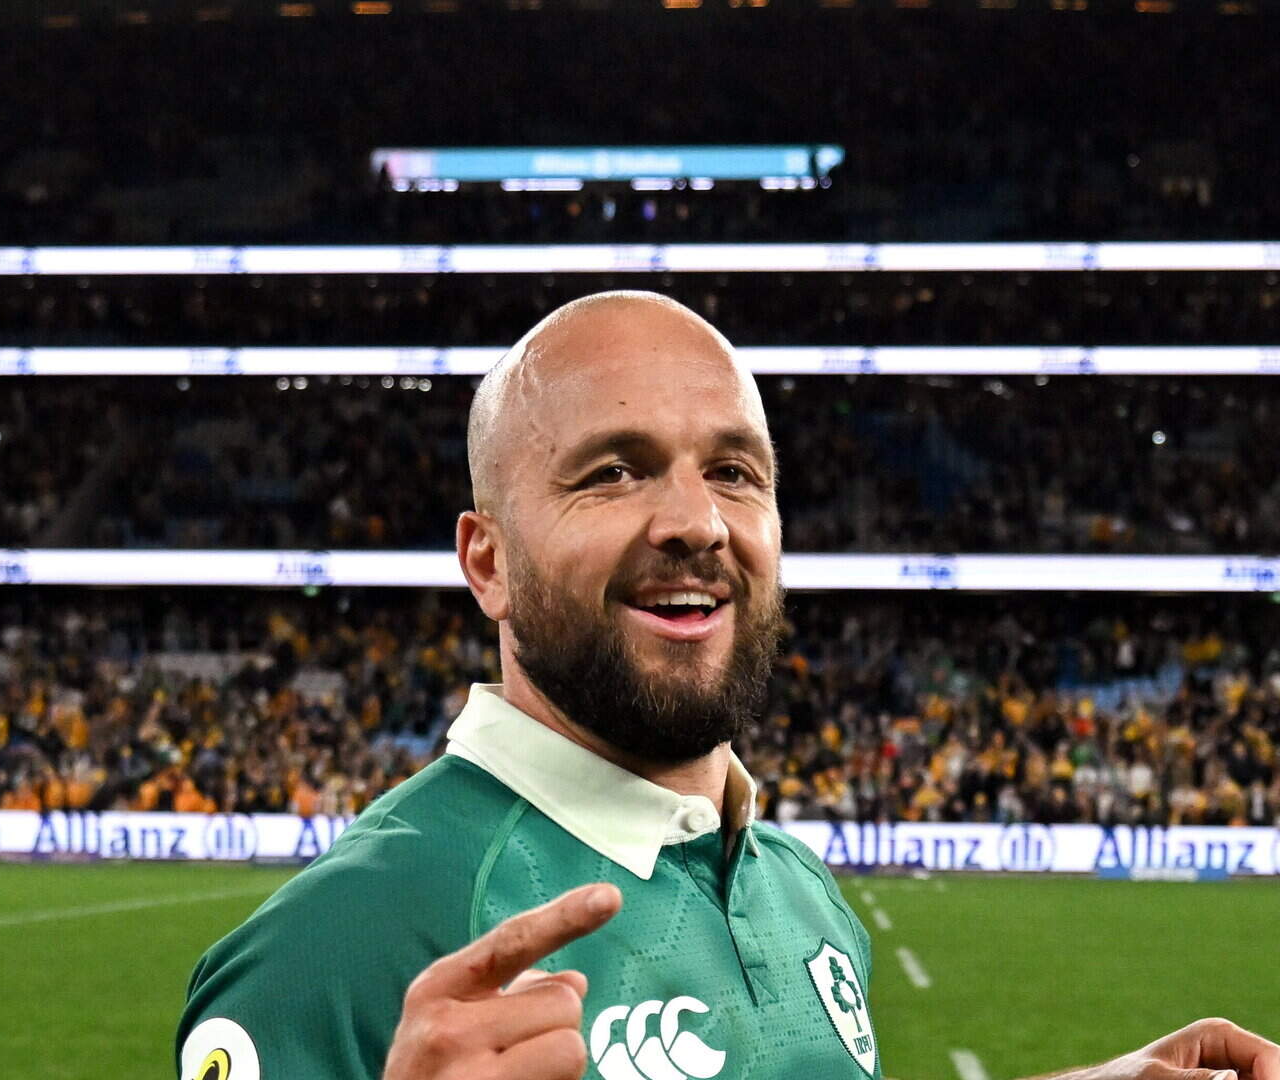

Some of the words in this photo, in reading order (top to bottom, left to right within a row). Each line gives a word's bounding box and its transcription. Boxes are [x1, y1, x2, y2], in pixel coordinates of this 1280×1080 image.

[34, 812, 187, 858] Allianz
[823, 821, 980, 867] Allianz
[1096, 825, 1256, 873] Allianz
